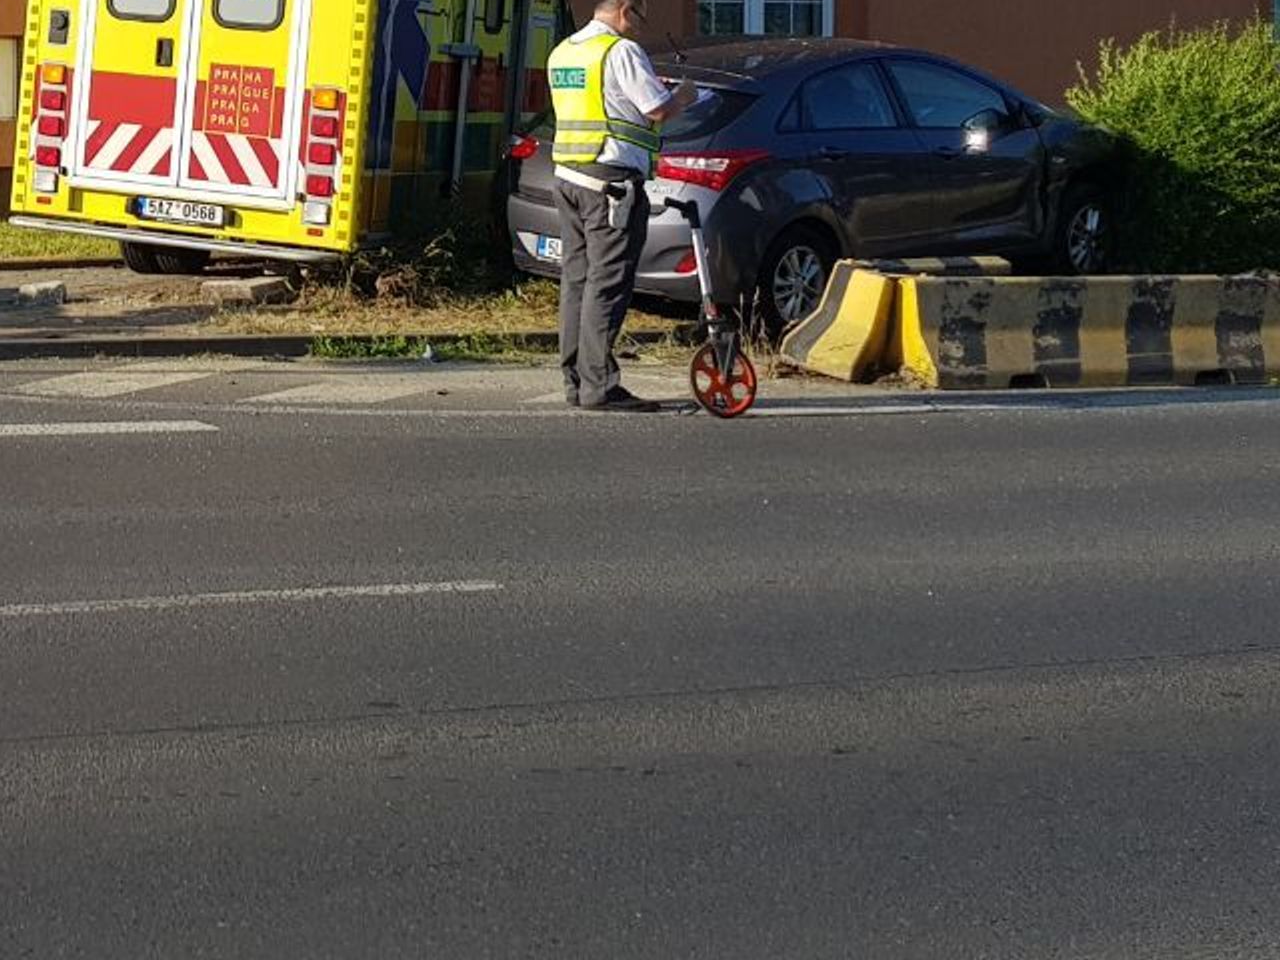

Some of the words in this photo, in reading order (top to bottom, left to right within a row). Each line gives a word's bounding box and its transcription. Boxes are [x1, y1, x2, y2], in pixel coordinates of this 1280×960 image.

[214, 68, 262, 83] PRAHA
[213, 84, 270, 100] PRAGUE
[211, 98, 260, 113] PRAGA
[209, 113, 250, 128] PRAG
